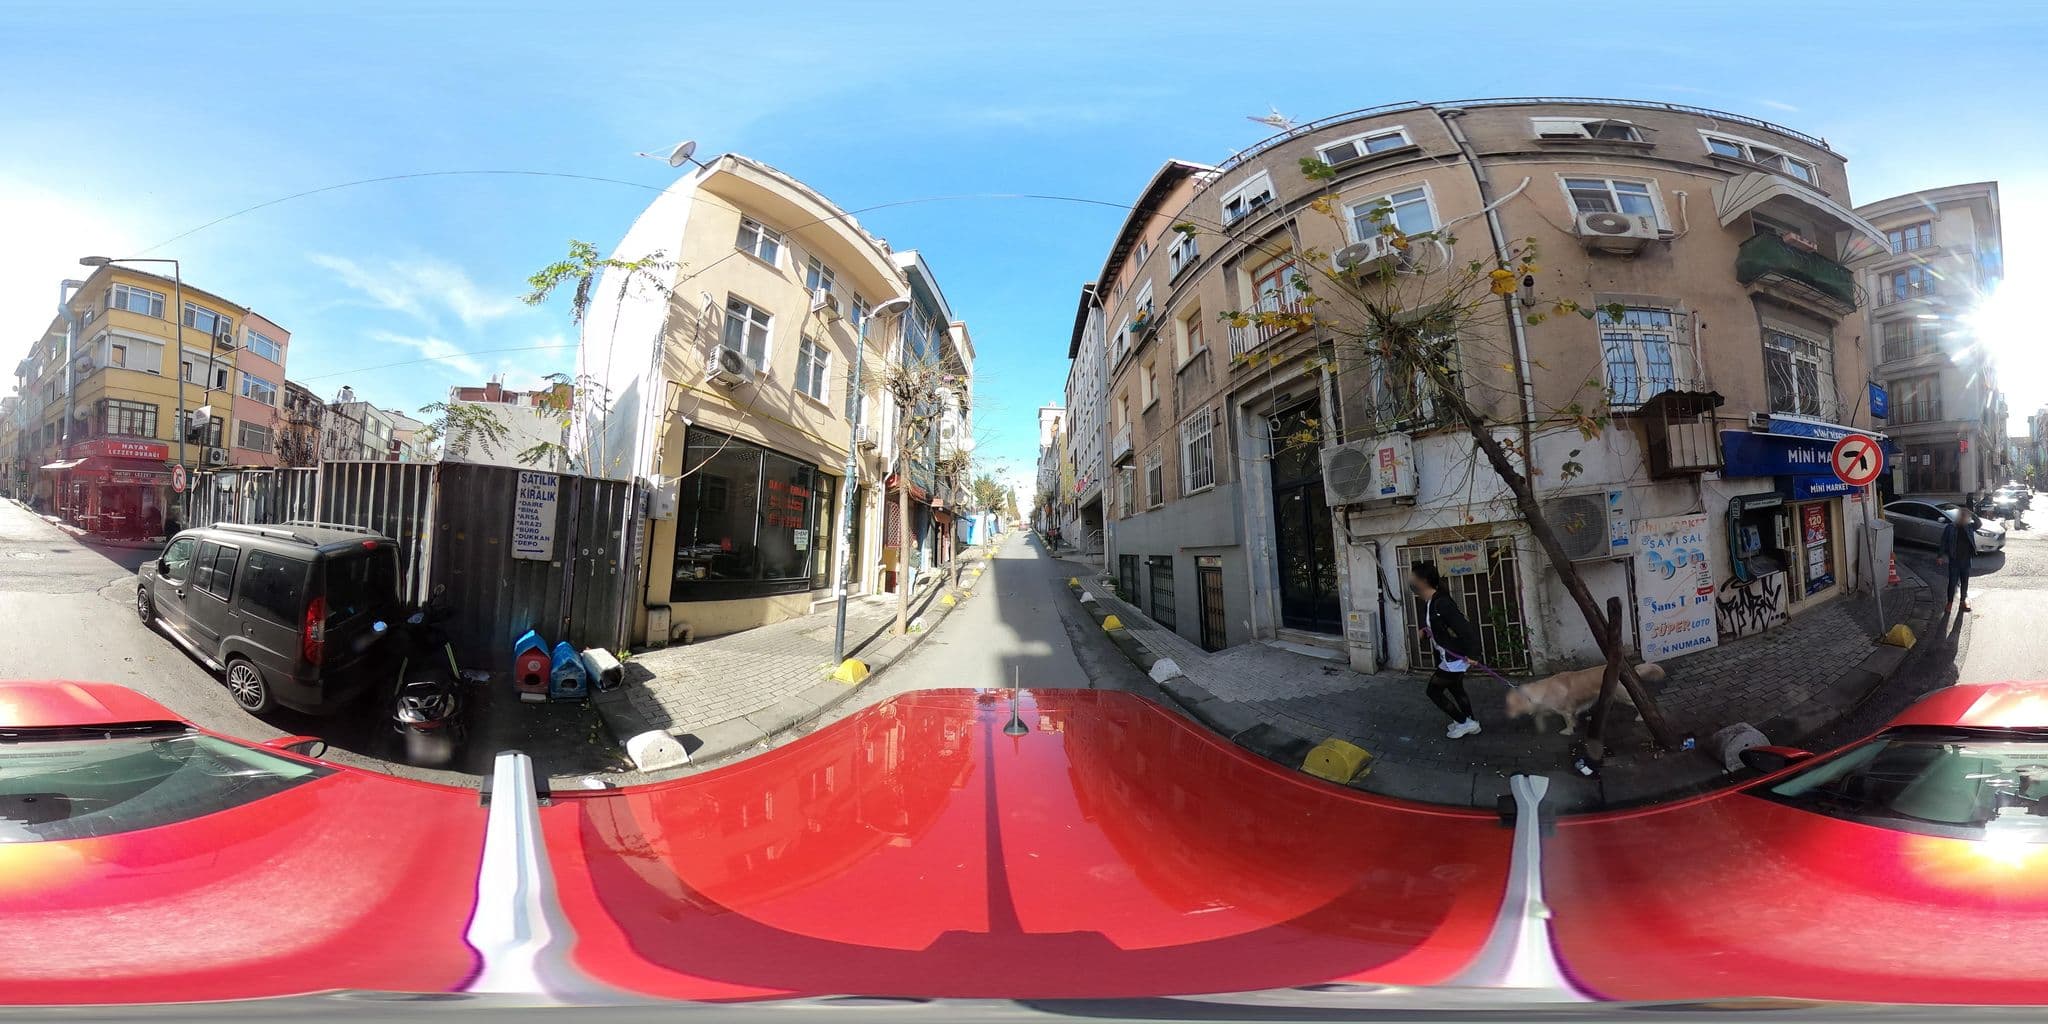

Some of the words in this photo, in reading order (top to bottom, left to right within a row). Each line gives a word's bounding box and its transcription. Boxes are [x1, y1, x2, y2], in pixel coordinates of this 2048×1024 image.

[1788, 446, 1815, 463] MİNİ
[521, 473, 557, 486] SATILIK
[1810, 482, 1825, 493] MİNİ
[1826, 483, 1849, 492] MARKET
[1649, 533, 1703, 549] SAYISAL
[1691, 618, 1710, 629] LOTO
[1671, 636, 1711, 652] NUMARA
